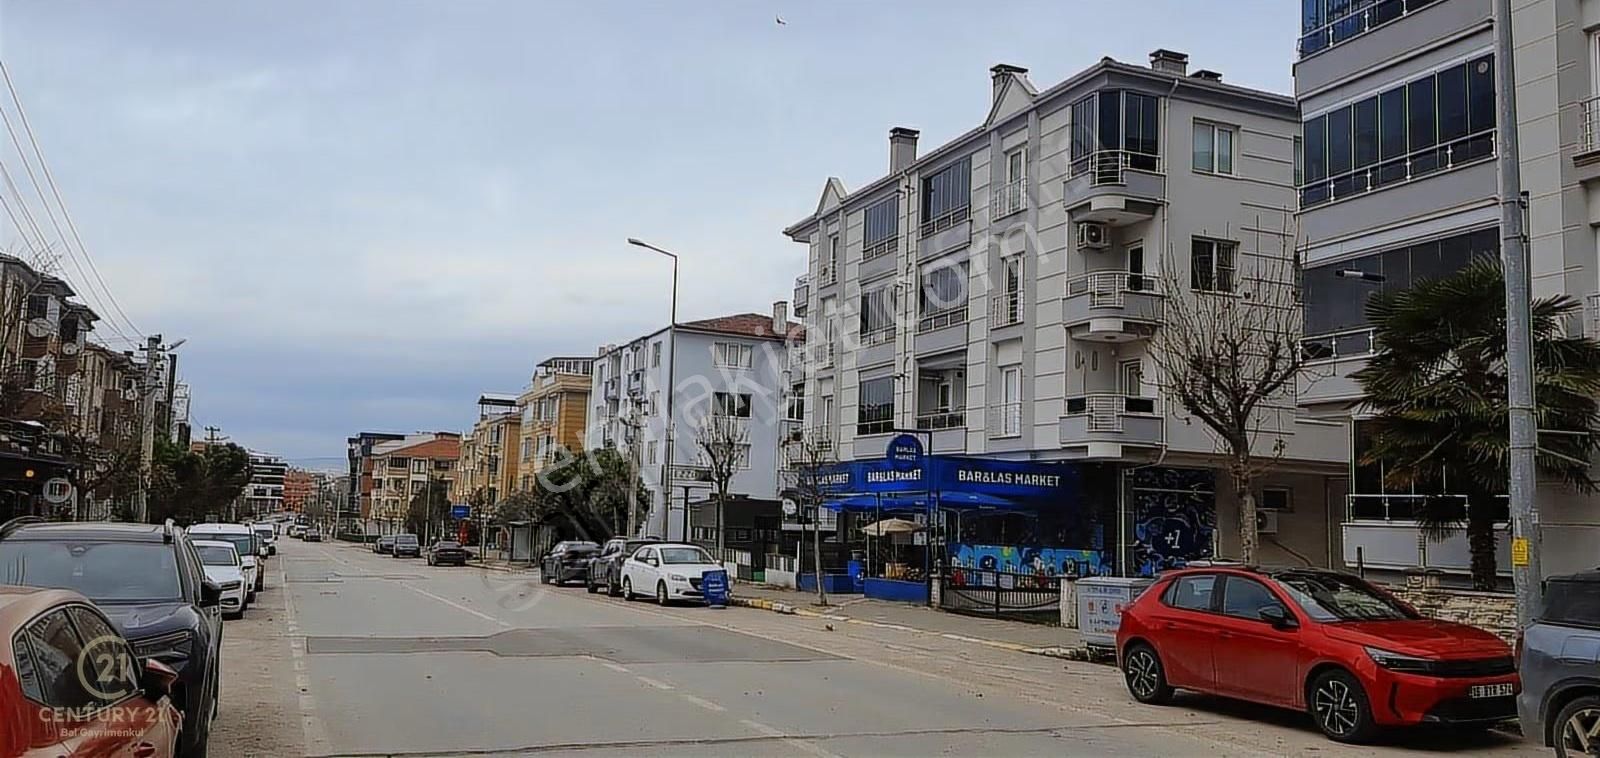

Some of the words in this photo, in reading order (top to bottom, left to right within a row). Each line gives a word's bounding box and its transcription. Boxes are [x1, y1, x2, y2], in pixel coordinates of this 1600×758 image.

[958, 469, 1012, 484] BAR&LAS
[1015, 473, 1060, 487] MARKET
[1164, 529, 1181, 549] +1
